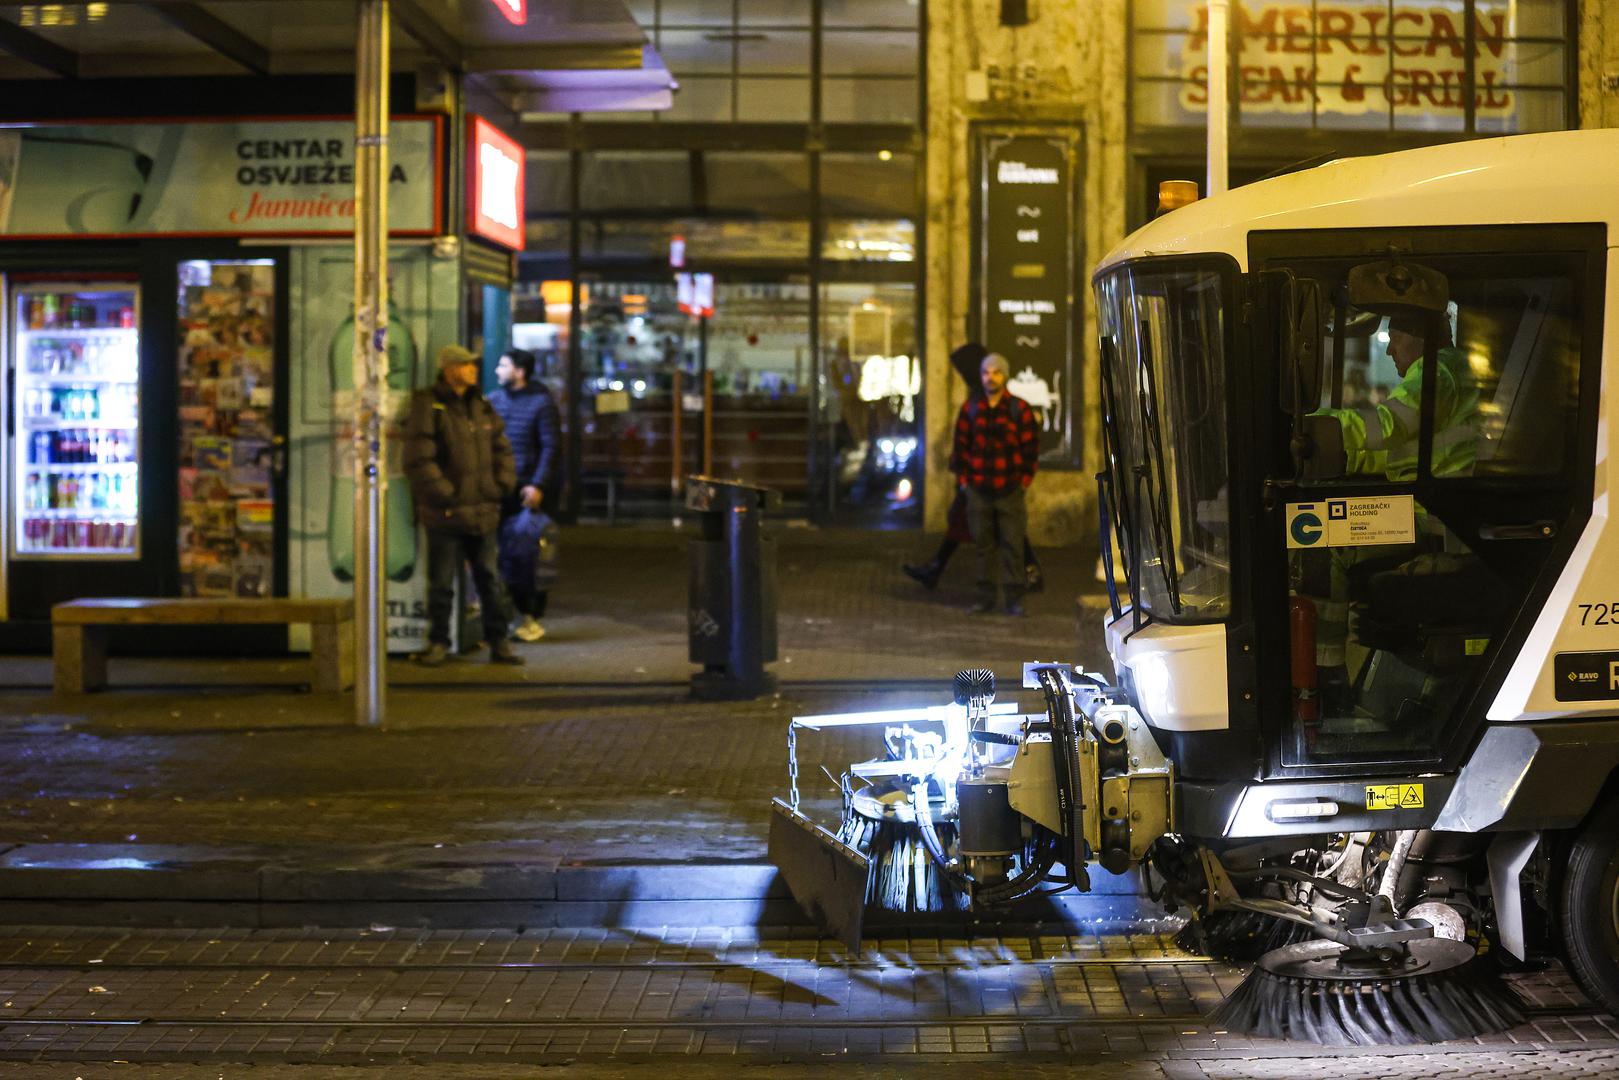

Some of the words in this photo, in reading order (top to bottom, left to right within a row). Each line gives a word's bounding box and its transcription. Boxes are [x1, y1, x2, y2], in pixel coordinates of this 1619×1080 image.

[1187, 65, 1321, 104] SEAK
[1382, 69, 1510, 109] GRILL
[237, 139, 343, 159] CENTAR
[237, 161, 407, 185] OSVJEŽEA
[228, 192, 355, 224] Jamnica
[1349, 502, 1391, 511] ZAGREBAČKI
[1578, 603, 1619, 626] 725
[1578, 672, 1599, 680] RAVO
